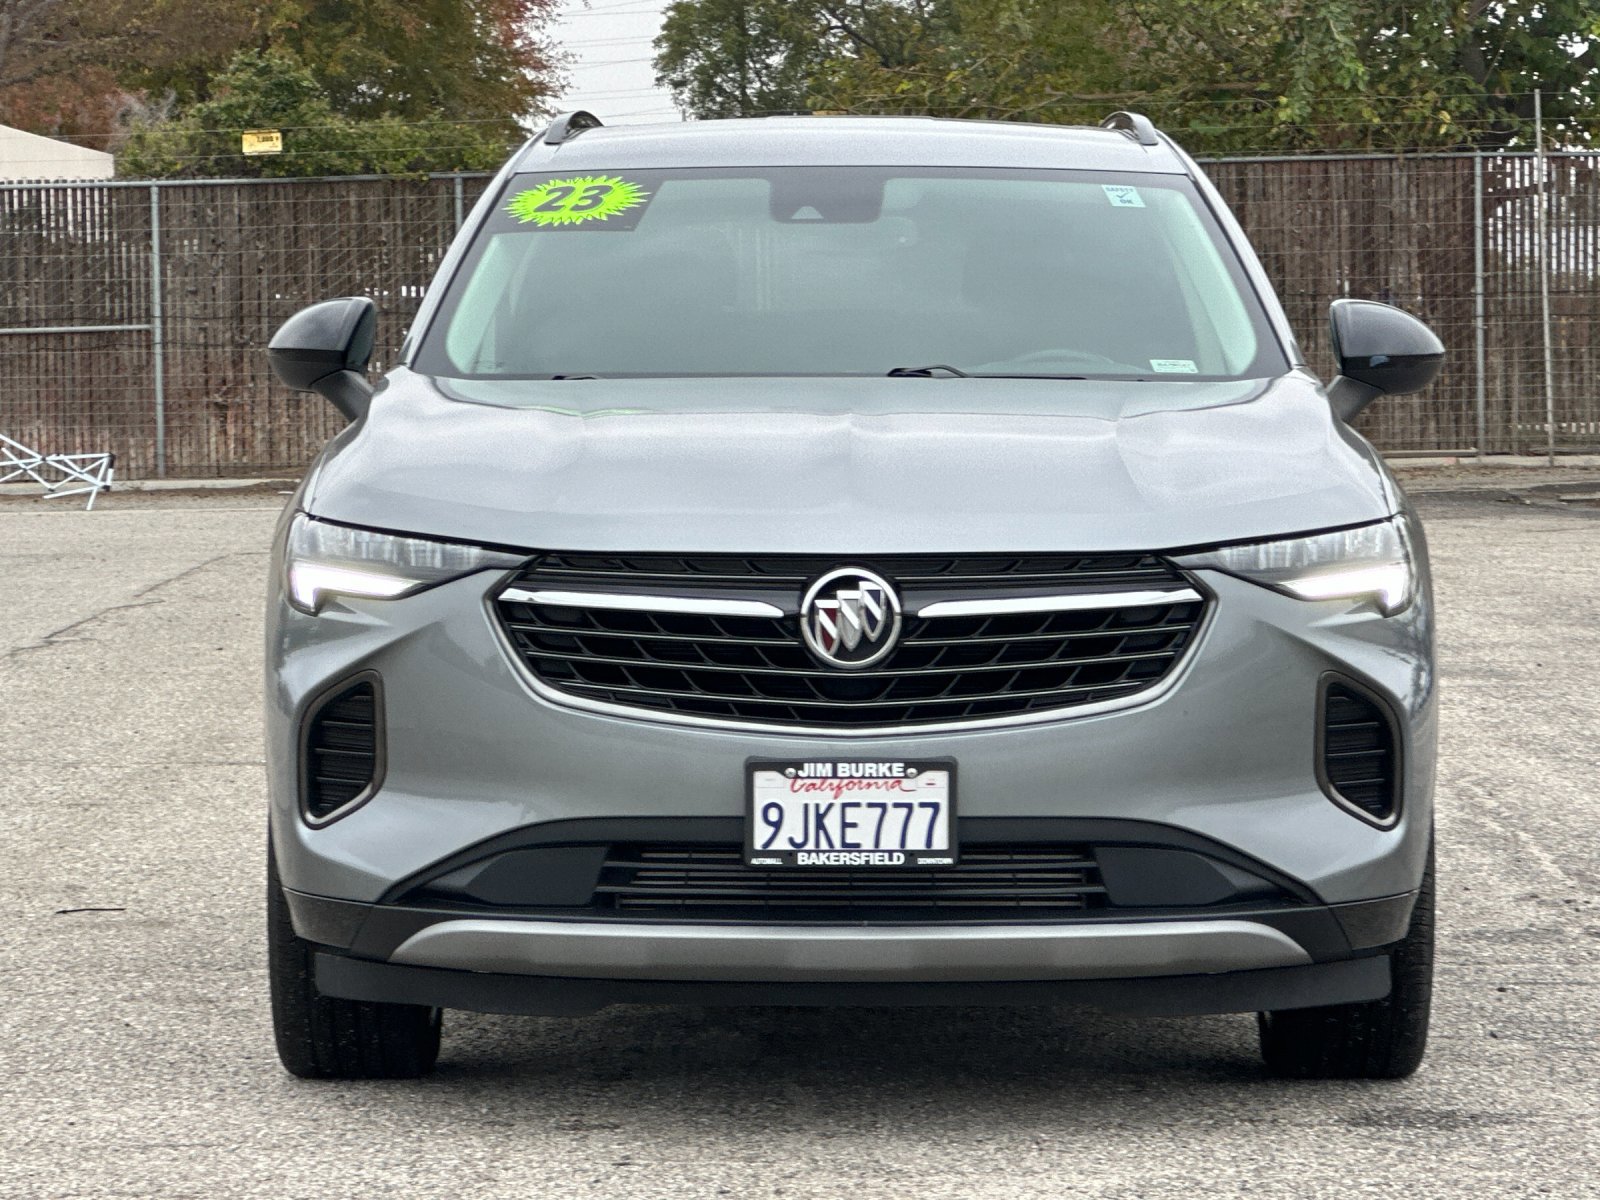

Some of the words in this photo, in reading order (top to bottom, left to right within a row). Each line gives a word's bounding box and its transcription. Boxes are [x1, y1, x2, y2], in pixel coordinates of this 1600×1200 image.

[533, 185, 615, 213] 23
[797, 762, 833, 778] JIM
[836, 762, 906, 778] BURKE
[790, 778, 917, 799] California
[761, 801, 941, 850] 9JKE777
[796, 852, 906, 866] BAKERSFIELD
